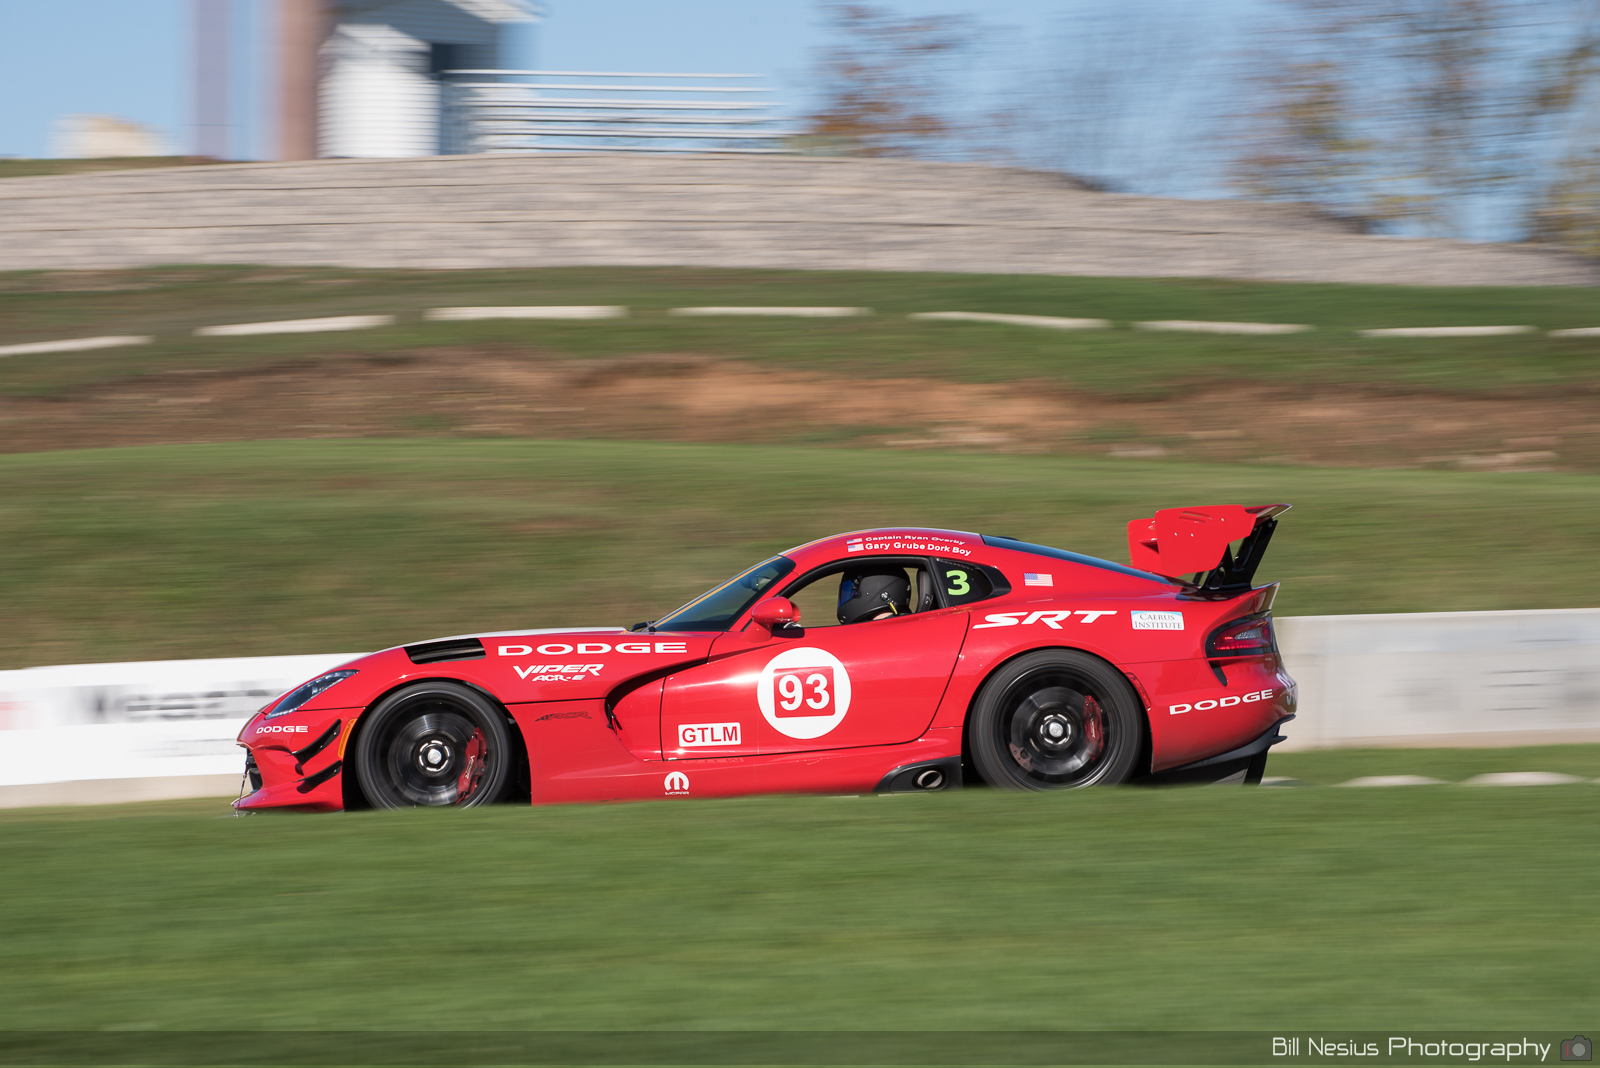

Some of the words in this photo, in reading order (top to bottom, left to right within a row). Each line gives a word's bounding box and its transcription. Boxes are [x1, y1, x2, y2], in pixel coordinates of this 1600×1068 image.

[865, 543, 891, 551] Gary
[893, 542, 926, 550] Grube
[927, 543, 950, 553] Dork
[952, 546, 972, 557] Boy
[931, 536, 966, 546] Overby
[946, 570, 971, 596] 3
[972, 610, 1118, 630] SRT
[498, 642, 688, 656] DODGE
[512, 663, 605, 680] VIPER
[532, 674, 586, 682] ACR-E
[778, 673, 830, 711] 93
[1169, 688, 1274, 715] DODGE
[256, 725, 309, 734] DODGE
[681, 726, 738, 743] GTLM
